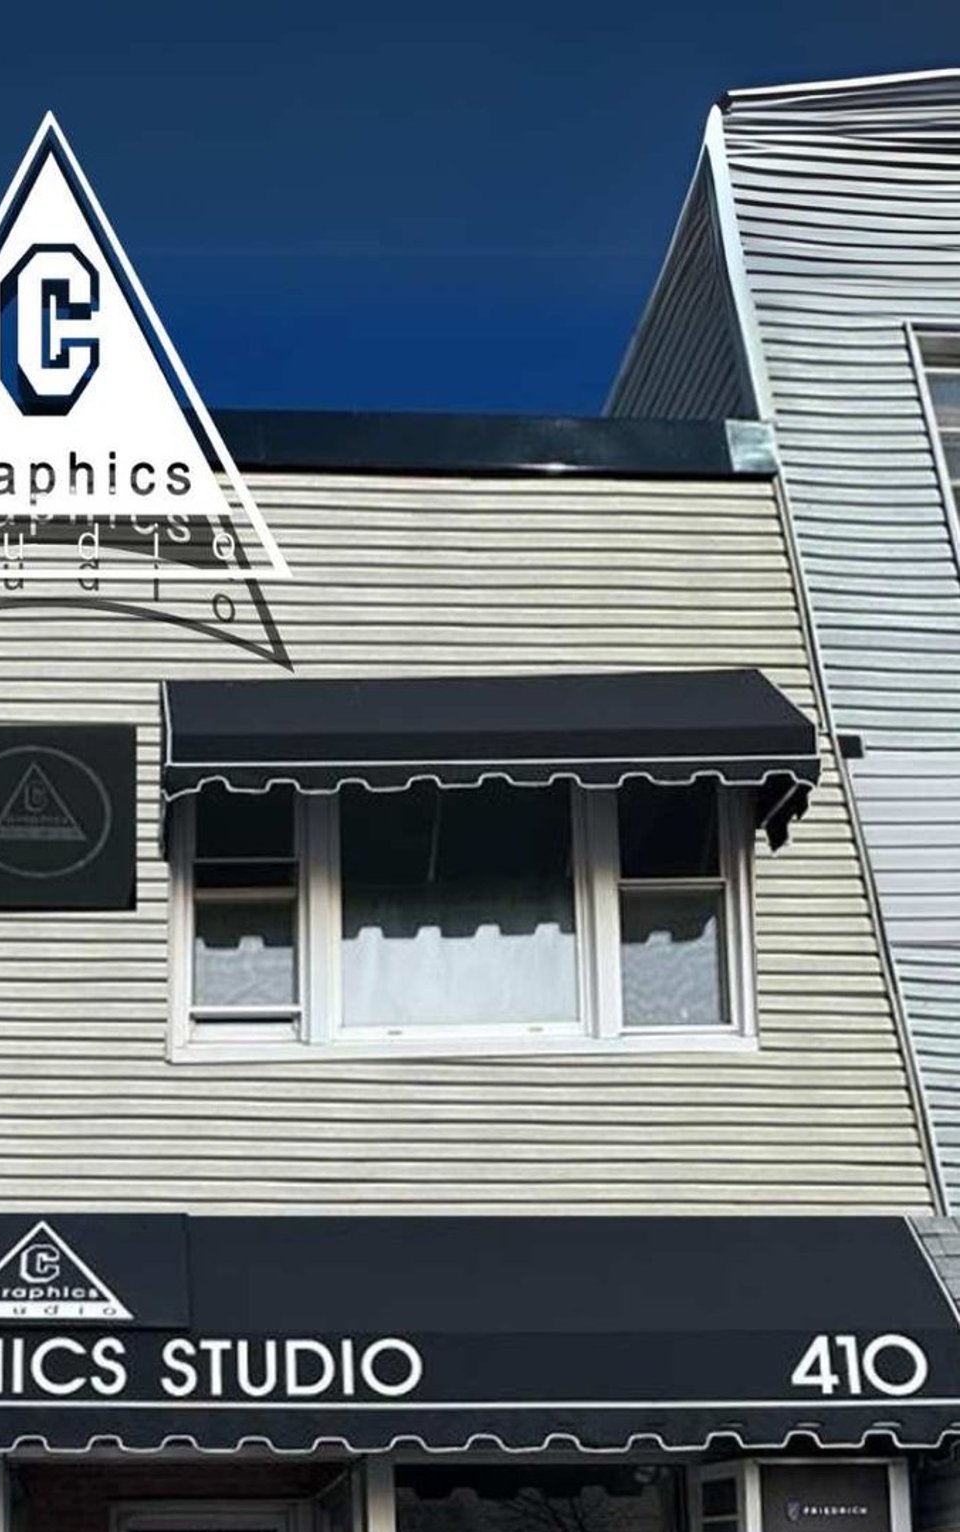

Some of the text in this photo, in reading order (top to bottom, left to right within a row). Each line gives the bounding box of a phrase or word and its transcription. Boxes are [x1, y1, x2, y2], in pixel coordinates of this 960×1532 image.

[19, 1244, 60, 1283] C
[160, 1338, 423, 1396] STUDIO
[791, 1333, 928, 1395] 410
